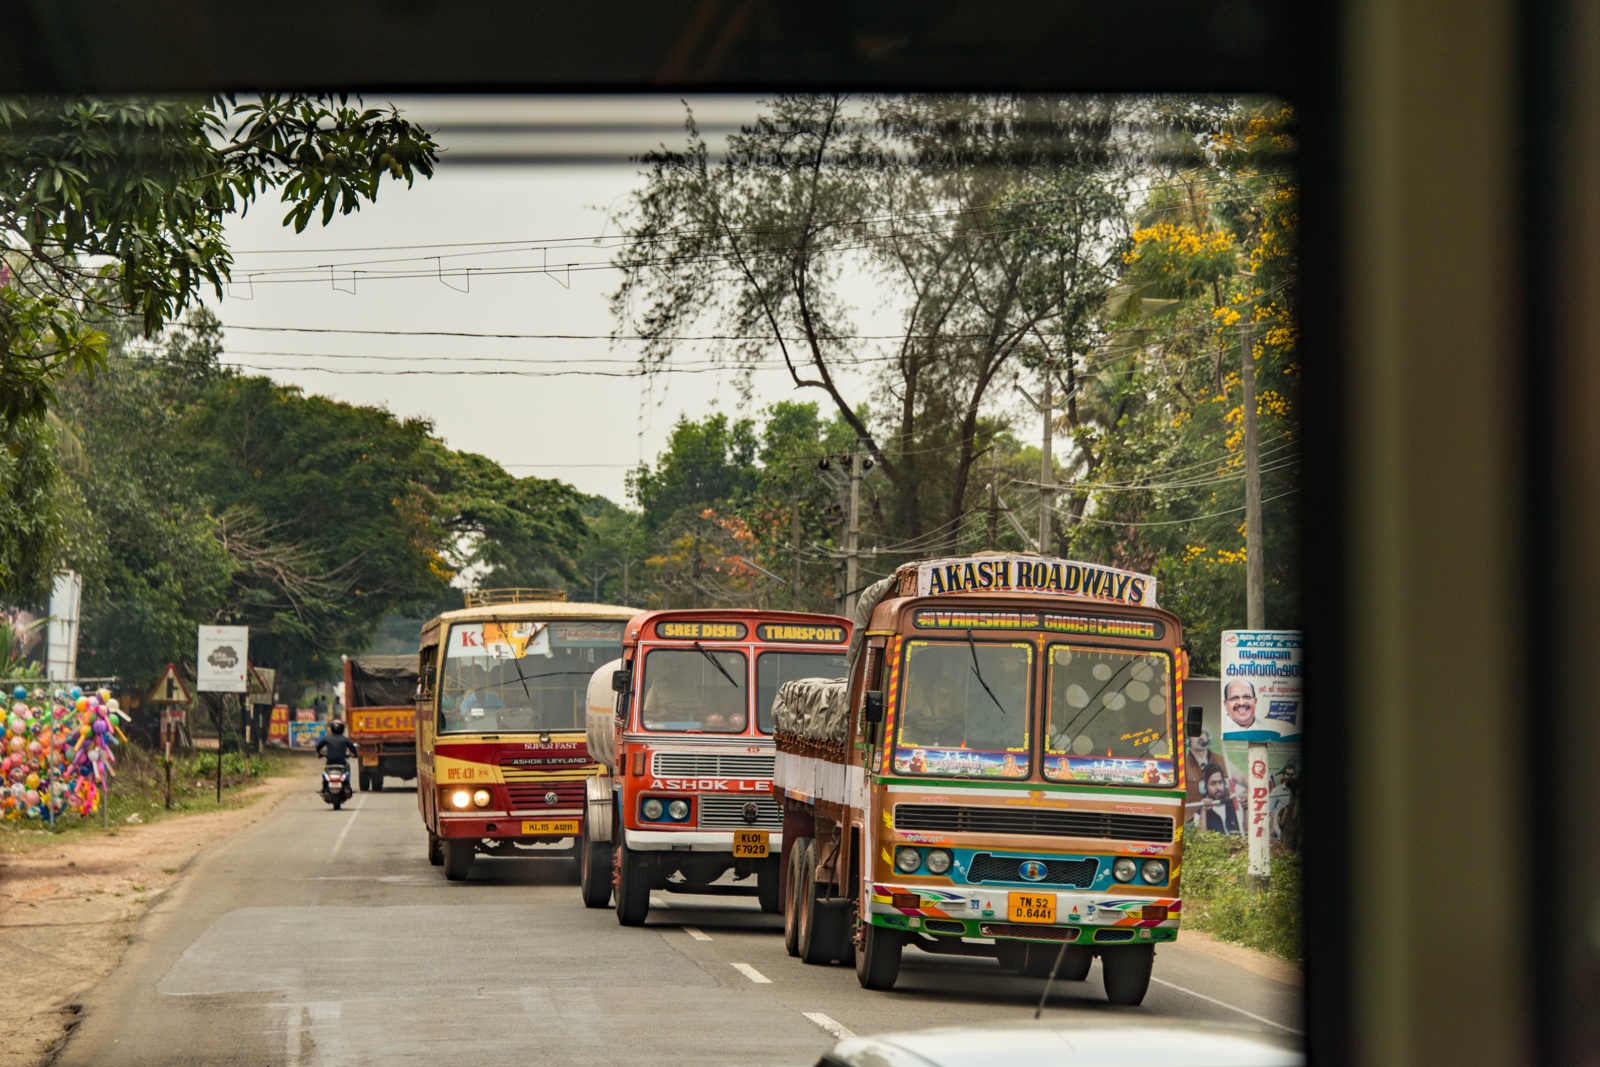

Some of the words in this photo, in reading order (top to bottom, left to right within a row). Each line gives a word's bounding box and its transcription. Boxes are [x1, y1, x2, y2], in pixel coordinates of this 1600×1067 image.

[928, 561, 1012, 596] AKASH
[1016, 561, 1146, 606] ROADWAYS
[936, 612, 1020, 628] VARSHA
[1044, 614, 1088, 632] GOODS
[1097, 618, 1154, 638] CARRIER
[664, 624, 699, 637] SREE
[702, 624, 737, 638] DISH
[764, 626, 842, 641] TRANSPORT
[1239, 650, 1291, 660] സംസ്ഥാന
[524, 742, 554, 750] SUPER
[555, 742, 577, 750] FAST
[650, 780, 728, 790] ASHOK
[739, 781, 774, 791] LE
[1020, 897, 1048, 908] TN.52
[1016, 908, 1051, 919] D.6441
